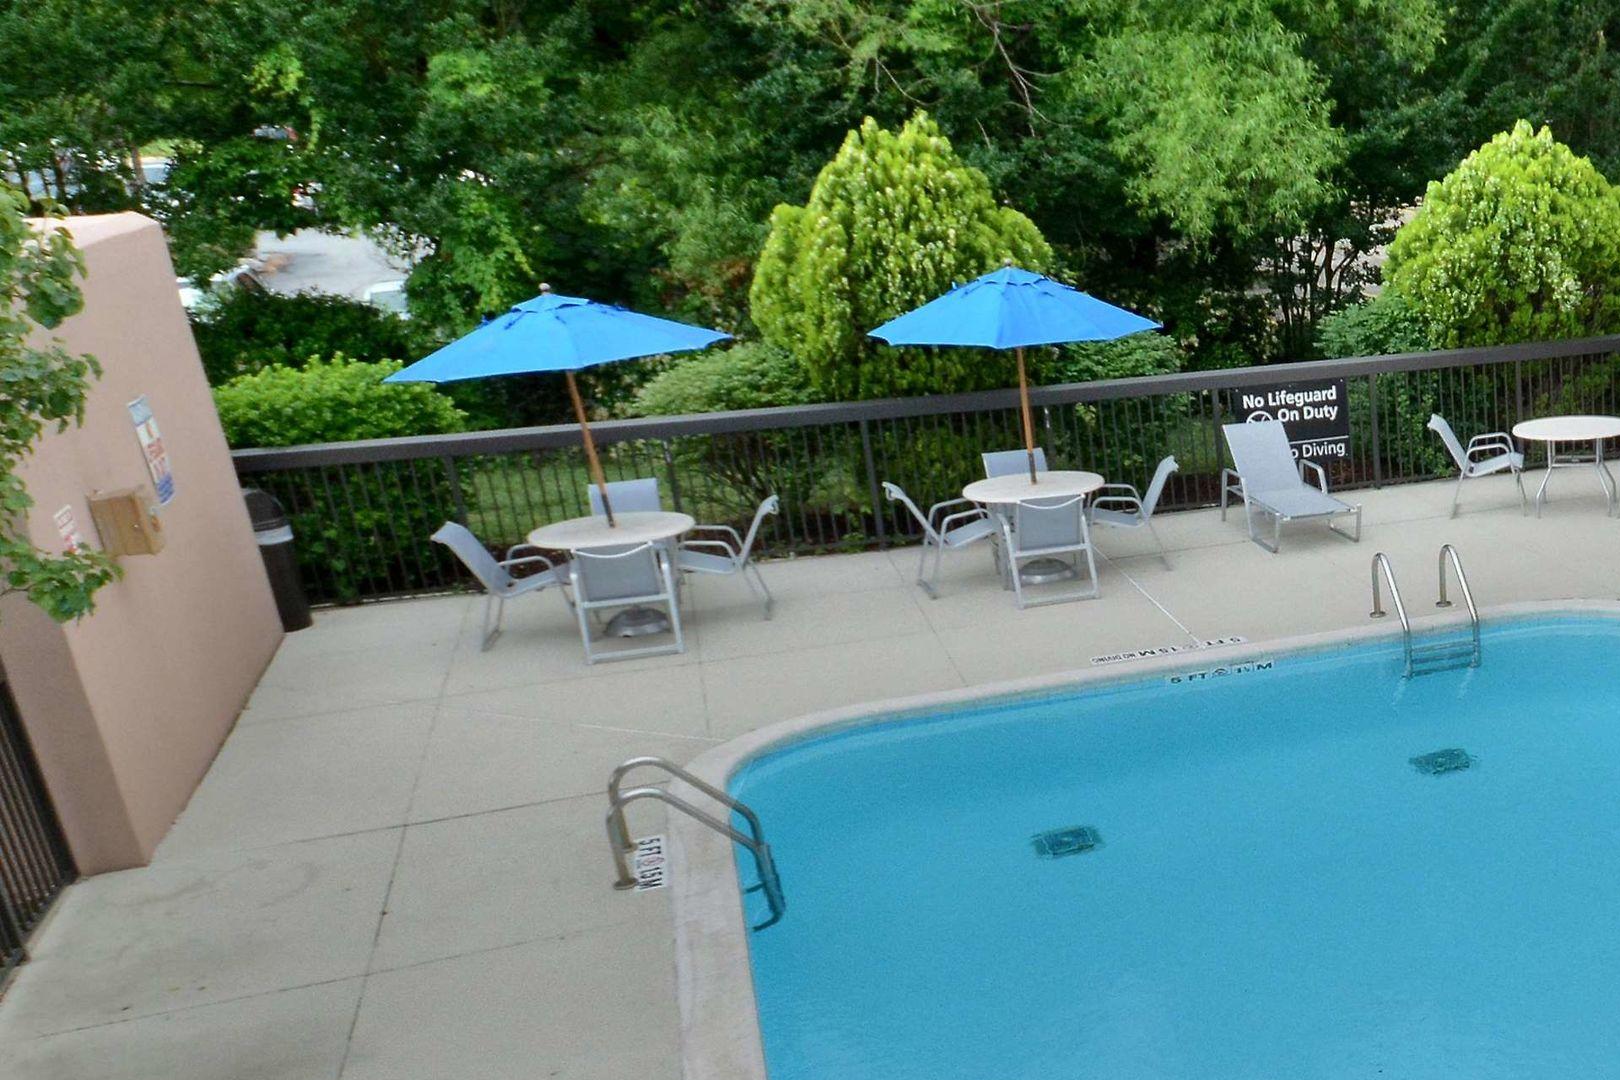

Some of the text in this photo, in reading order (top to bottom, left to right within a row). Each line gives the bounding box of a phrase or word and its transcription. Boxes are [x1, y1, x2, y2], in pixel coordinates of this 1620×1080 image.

[1242, 385, 1337, 409] No Lifeguard
[1277, 405, 1338, 422] On Duty
[1188, 672, 1207, 681] FT
[1257, 662, 1273, 671] M
[639, 846, 662, 857] FT
